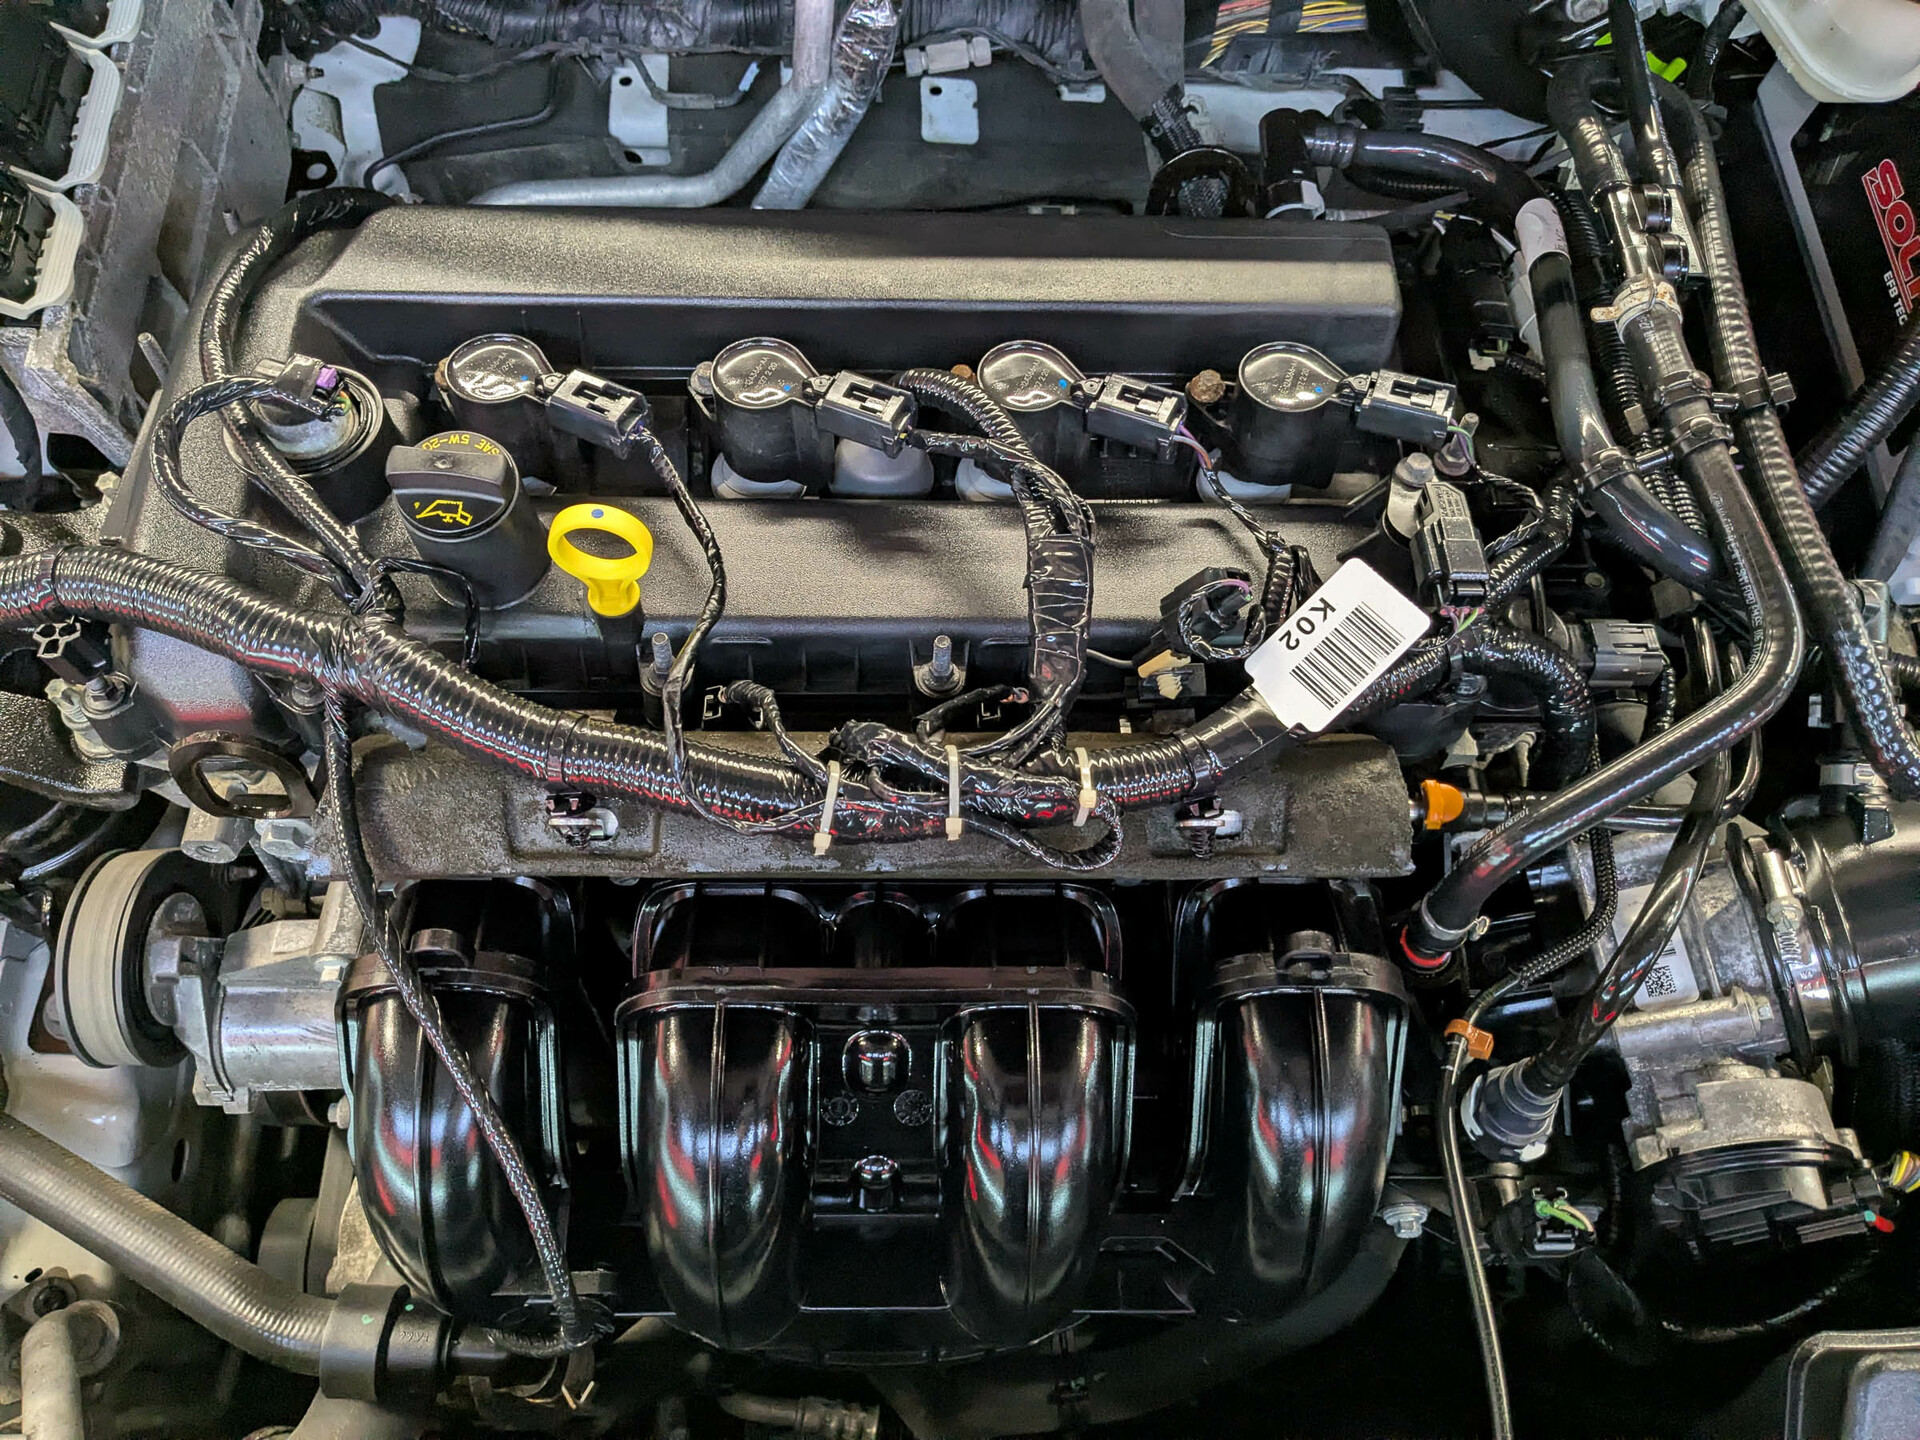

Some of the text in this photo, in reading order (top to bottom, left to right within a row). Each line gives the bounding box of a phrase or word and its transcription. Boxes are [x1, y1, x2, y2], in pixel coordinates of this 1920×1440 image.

[1884, 270, 1898, 298] EFB
[422, 434, 500, 455] SAE 5W-20
[1278, 597, 1336, 651] K02
